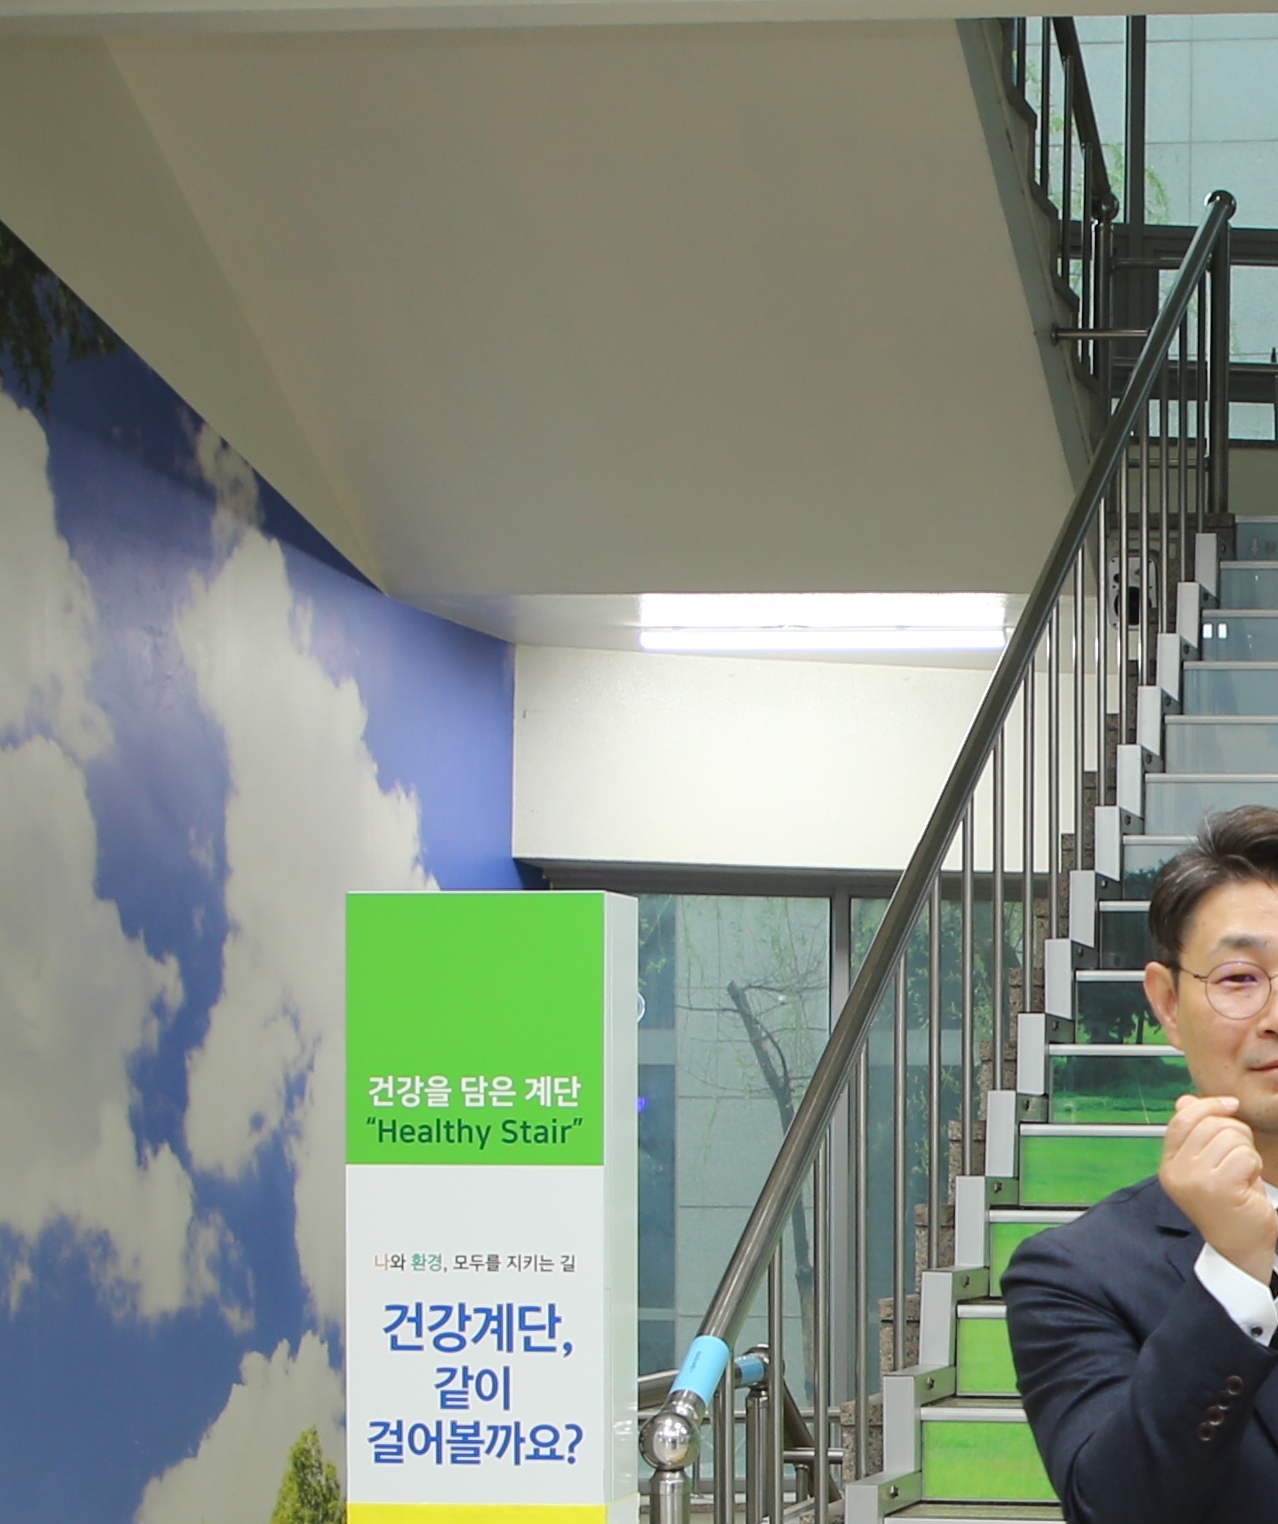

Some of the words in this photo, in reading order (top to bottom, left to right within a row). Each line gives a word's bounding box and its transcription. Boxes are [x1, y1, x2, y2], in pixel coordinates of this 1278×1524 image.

[368, 1075, 453, 1108] 건강을
[459, 1075, 517, 1108] 담은
[524, 1075, 582, 1108] 계단
[374, 1253, 406, 1272] 나와
[411, 1253, 448, 1273] 환경,
[453, 1253, 501, 1273] 모두를
[506, 1253, 555, 1272] 지키는
[559, 1253, 577, 1273] 길
[382, 1302, 573, 1358] 건강계단,
[434, 1365, 510, 1411] 같이
[367, 1419, 583, 1466] 걸어볼까요?
